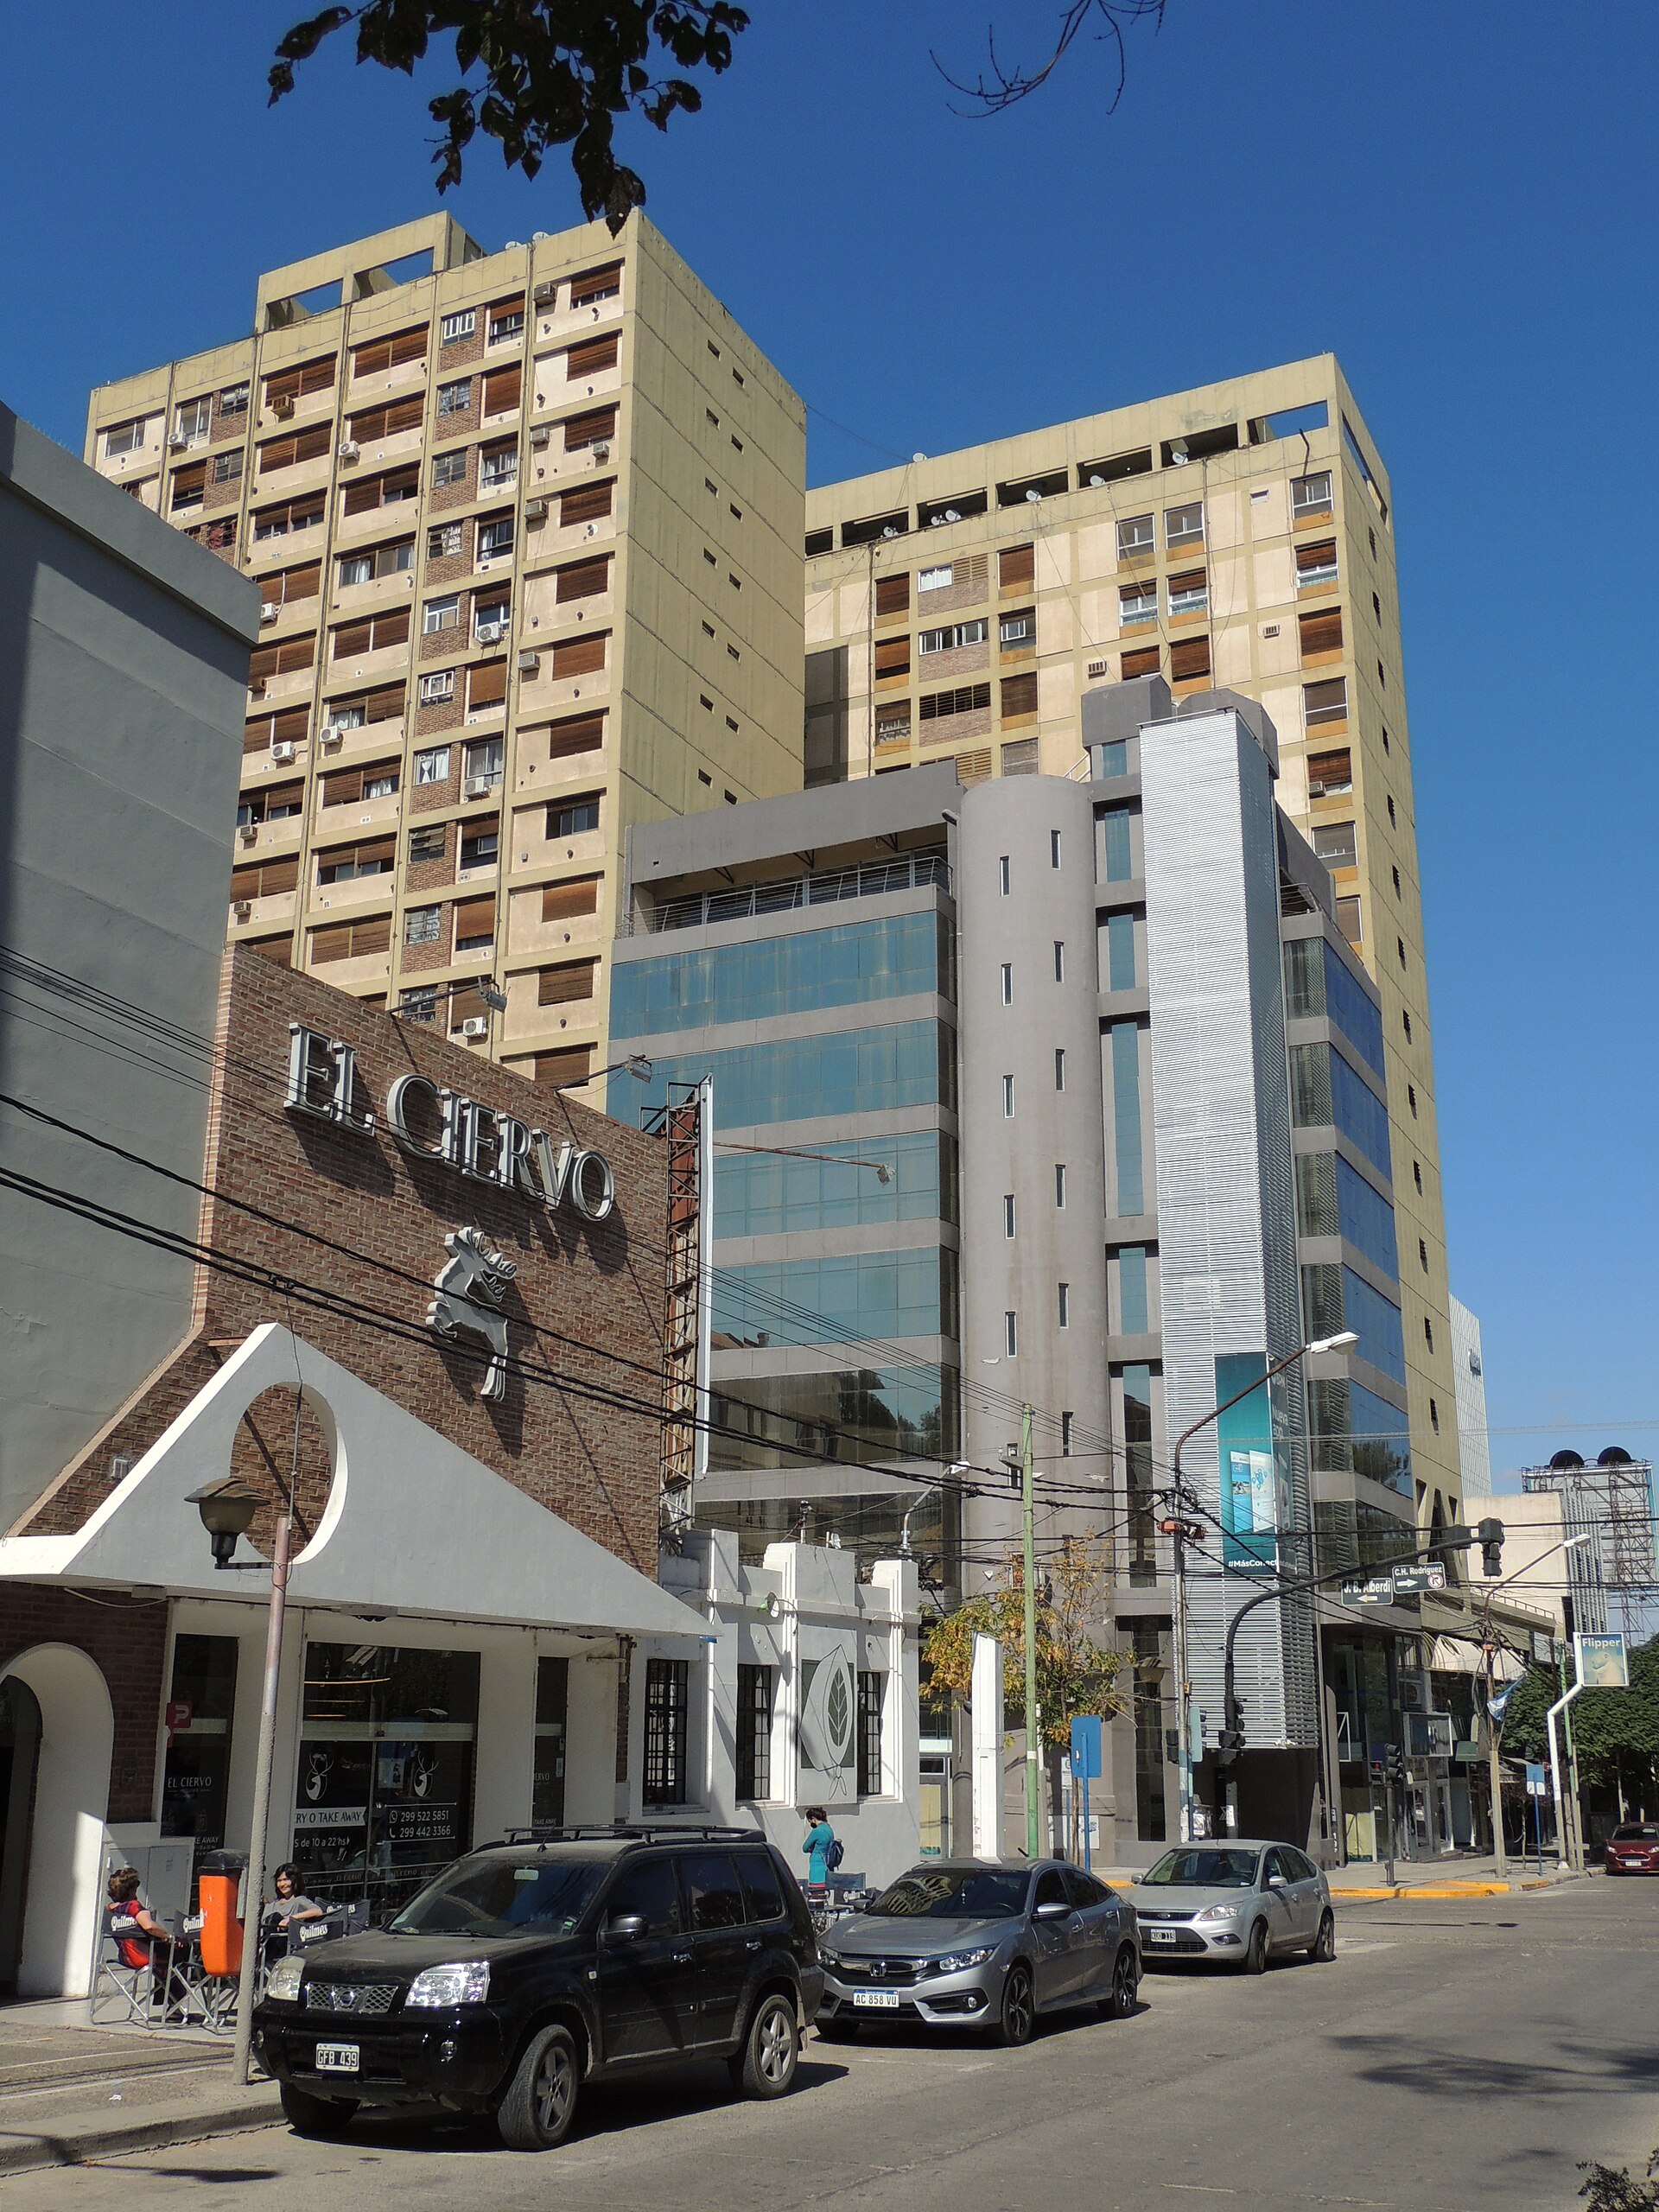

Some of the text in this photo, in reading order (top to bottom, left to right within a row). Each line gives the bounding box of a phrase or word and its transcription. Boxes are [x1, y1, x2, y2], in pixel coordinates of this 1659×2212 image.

[283, 1022, 614, 1223] EL CIERVO
[1409, 1566, 1443, 1575] Rodríguez
[1344, 1580, 1391, 1593] J. B. Alberdi
[1582, 1637, 1621, 1649] Flipper
[168, 1776, 213, 1788] EL CIERVO
[309, 1812, 316, 1823] O
[318, 1811, 340, 1823] TAKE
[340, 1811, 361, 1822] AWAY
[400, 1810, 448, 1822] 299 522 5851
[399, 1825, 451, 1838] 299 442 3366
[201, 1835, 219, 1844] AWAY
[301, 1838, 310, 1847] de
[312, 1837, 321, 1847] 10
[328, 1837, 337, 1847] 22
[300, 1923, 328, 1942] Quilmes
[855, 1994, 897, 2005] AC 858 VU
[318, 2050, 357, 2066] GFB 439
